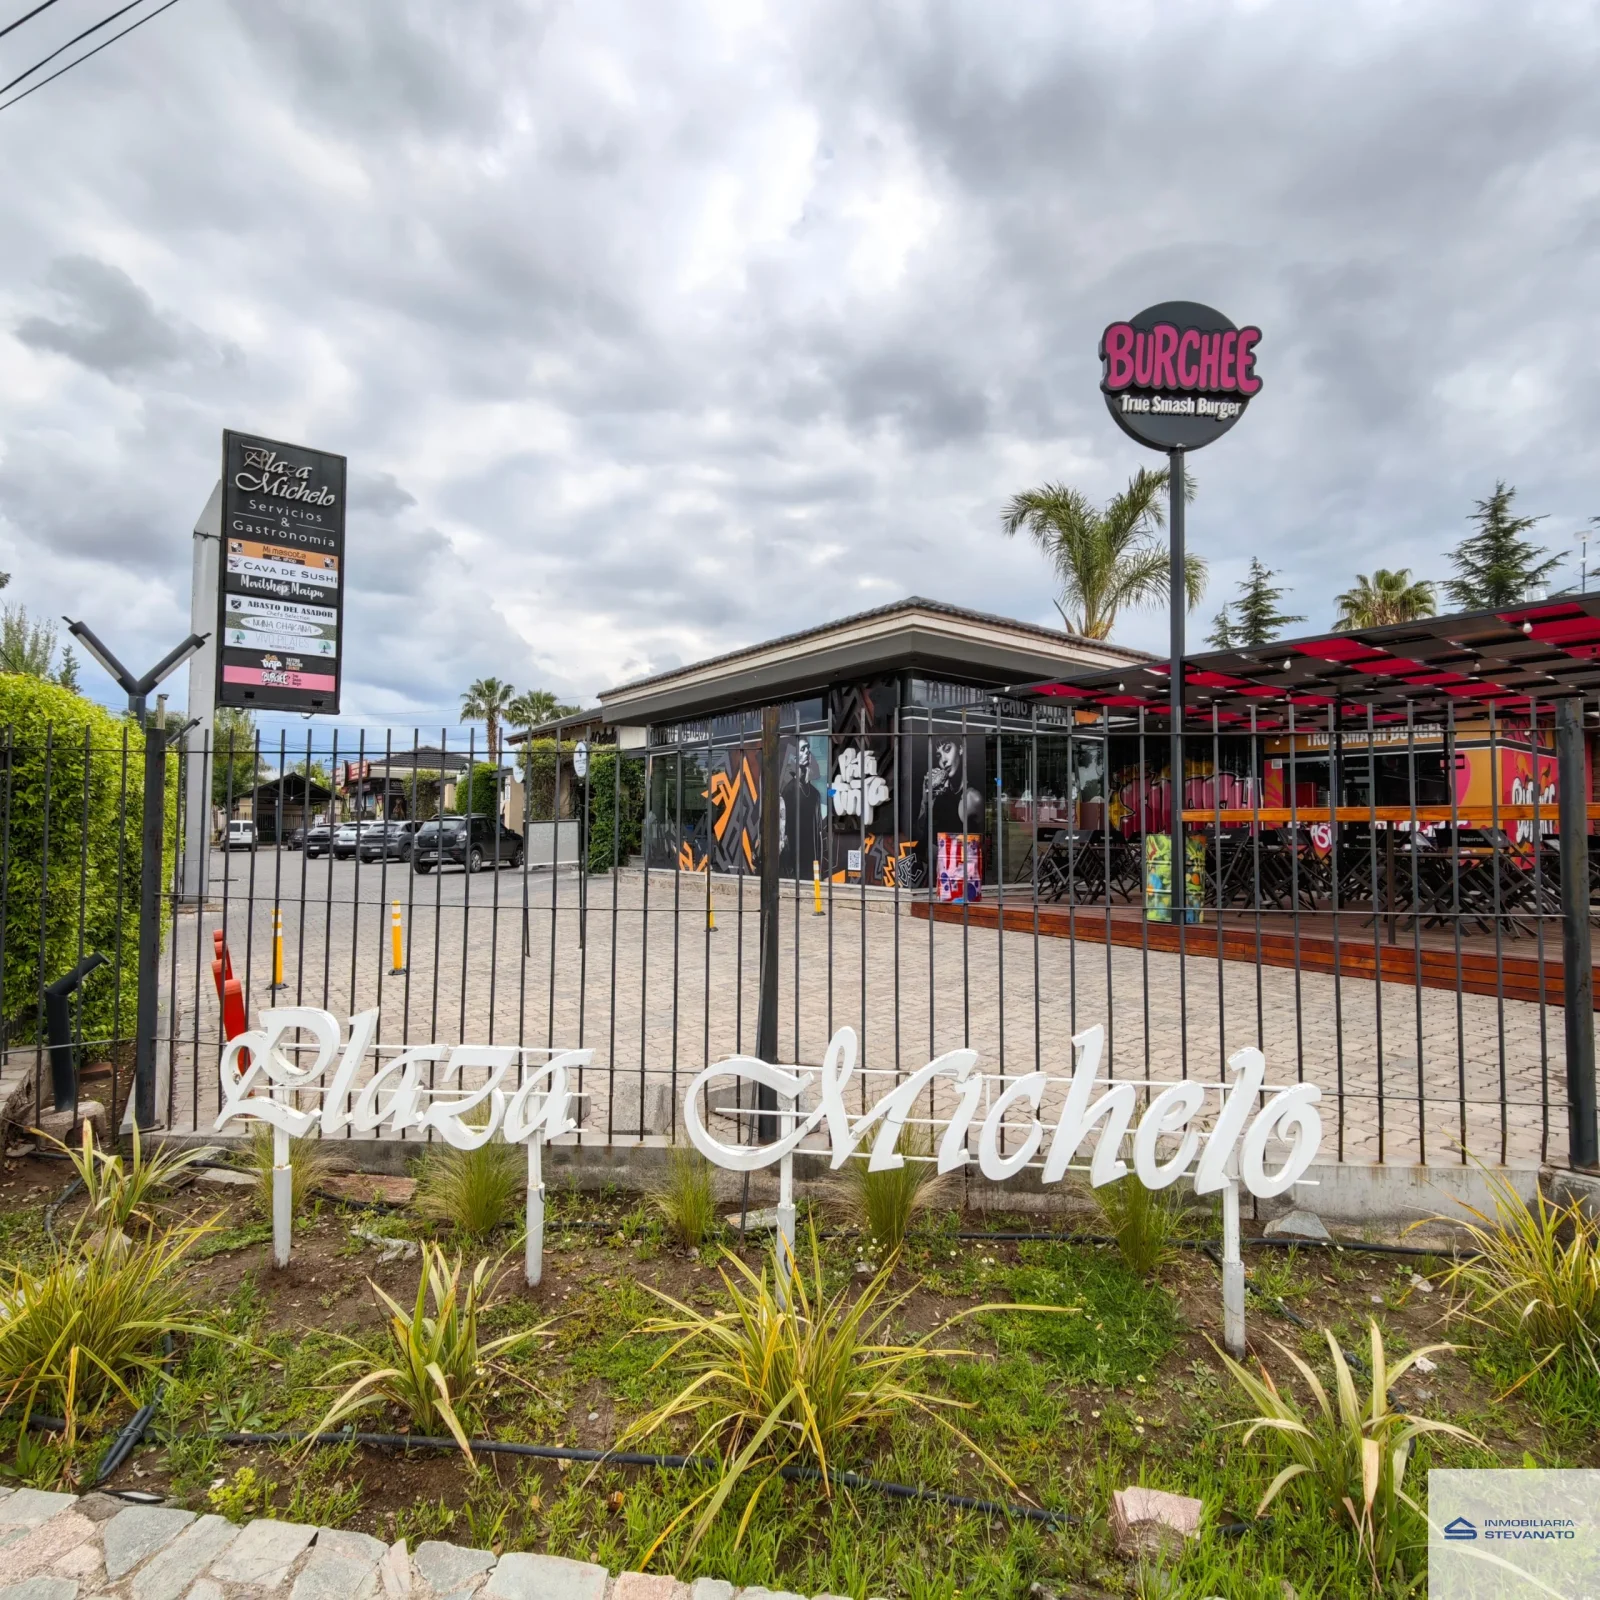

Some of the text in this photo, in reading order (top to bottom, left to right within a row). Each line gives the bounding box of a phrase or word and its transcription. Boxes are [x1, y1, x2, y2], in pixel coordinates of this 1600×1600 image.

[1104, 323, 1261, 393] BURCHEE
[1121, 395, 1241, 420] True Smash Burger
[241, 443, 313, 478] Plaza
[235, 473, 335, 506] Michelo
[249, 500, 322, 522] Servicios
[280, 517, 290, 527] &
[233, 520, 335, 547] Gastronomía
[272, 549, 307, 559] mascota
[244, 562, 337, 584] CAVA DE SUSHI
[247, 600, 333, 618] ABASTO DEL ASADOR
[277, 635, 310, 649] PILATES
[213, 1006, 597, 1151] Plaza
[683, 1023, 1322, 1199] Michelo
